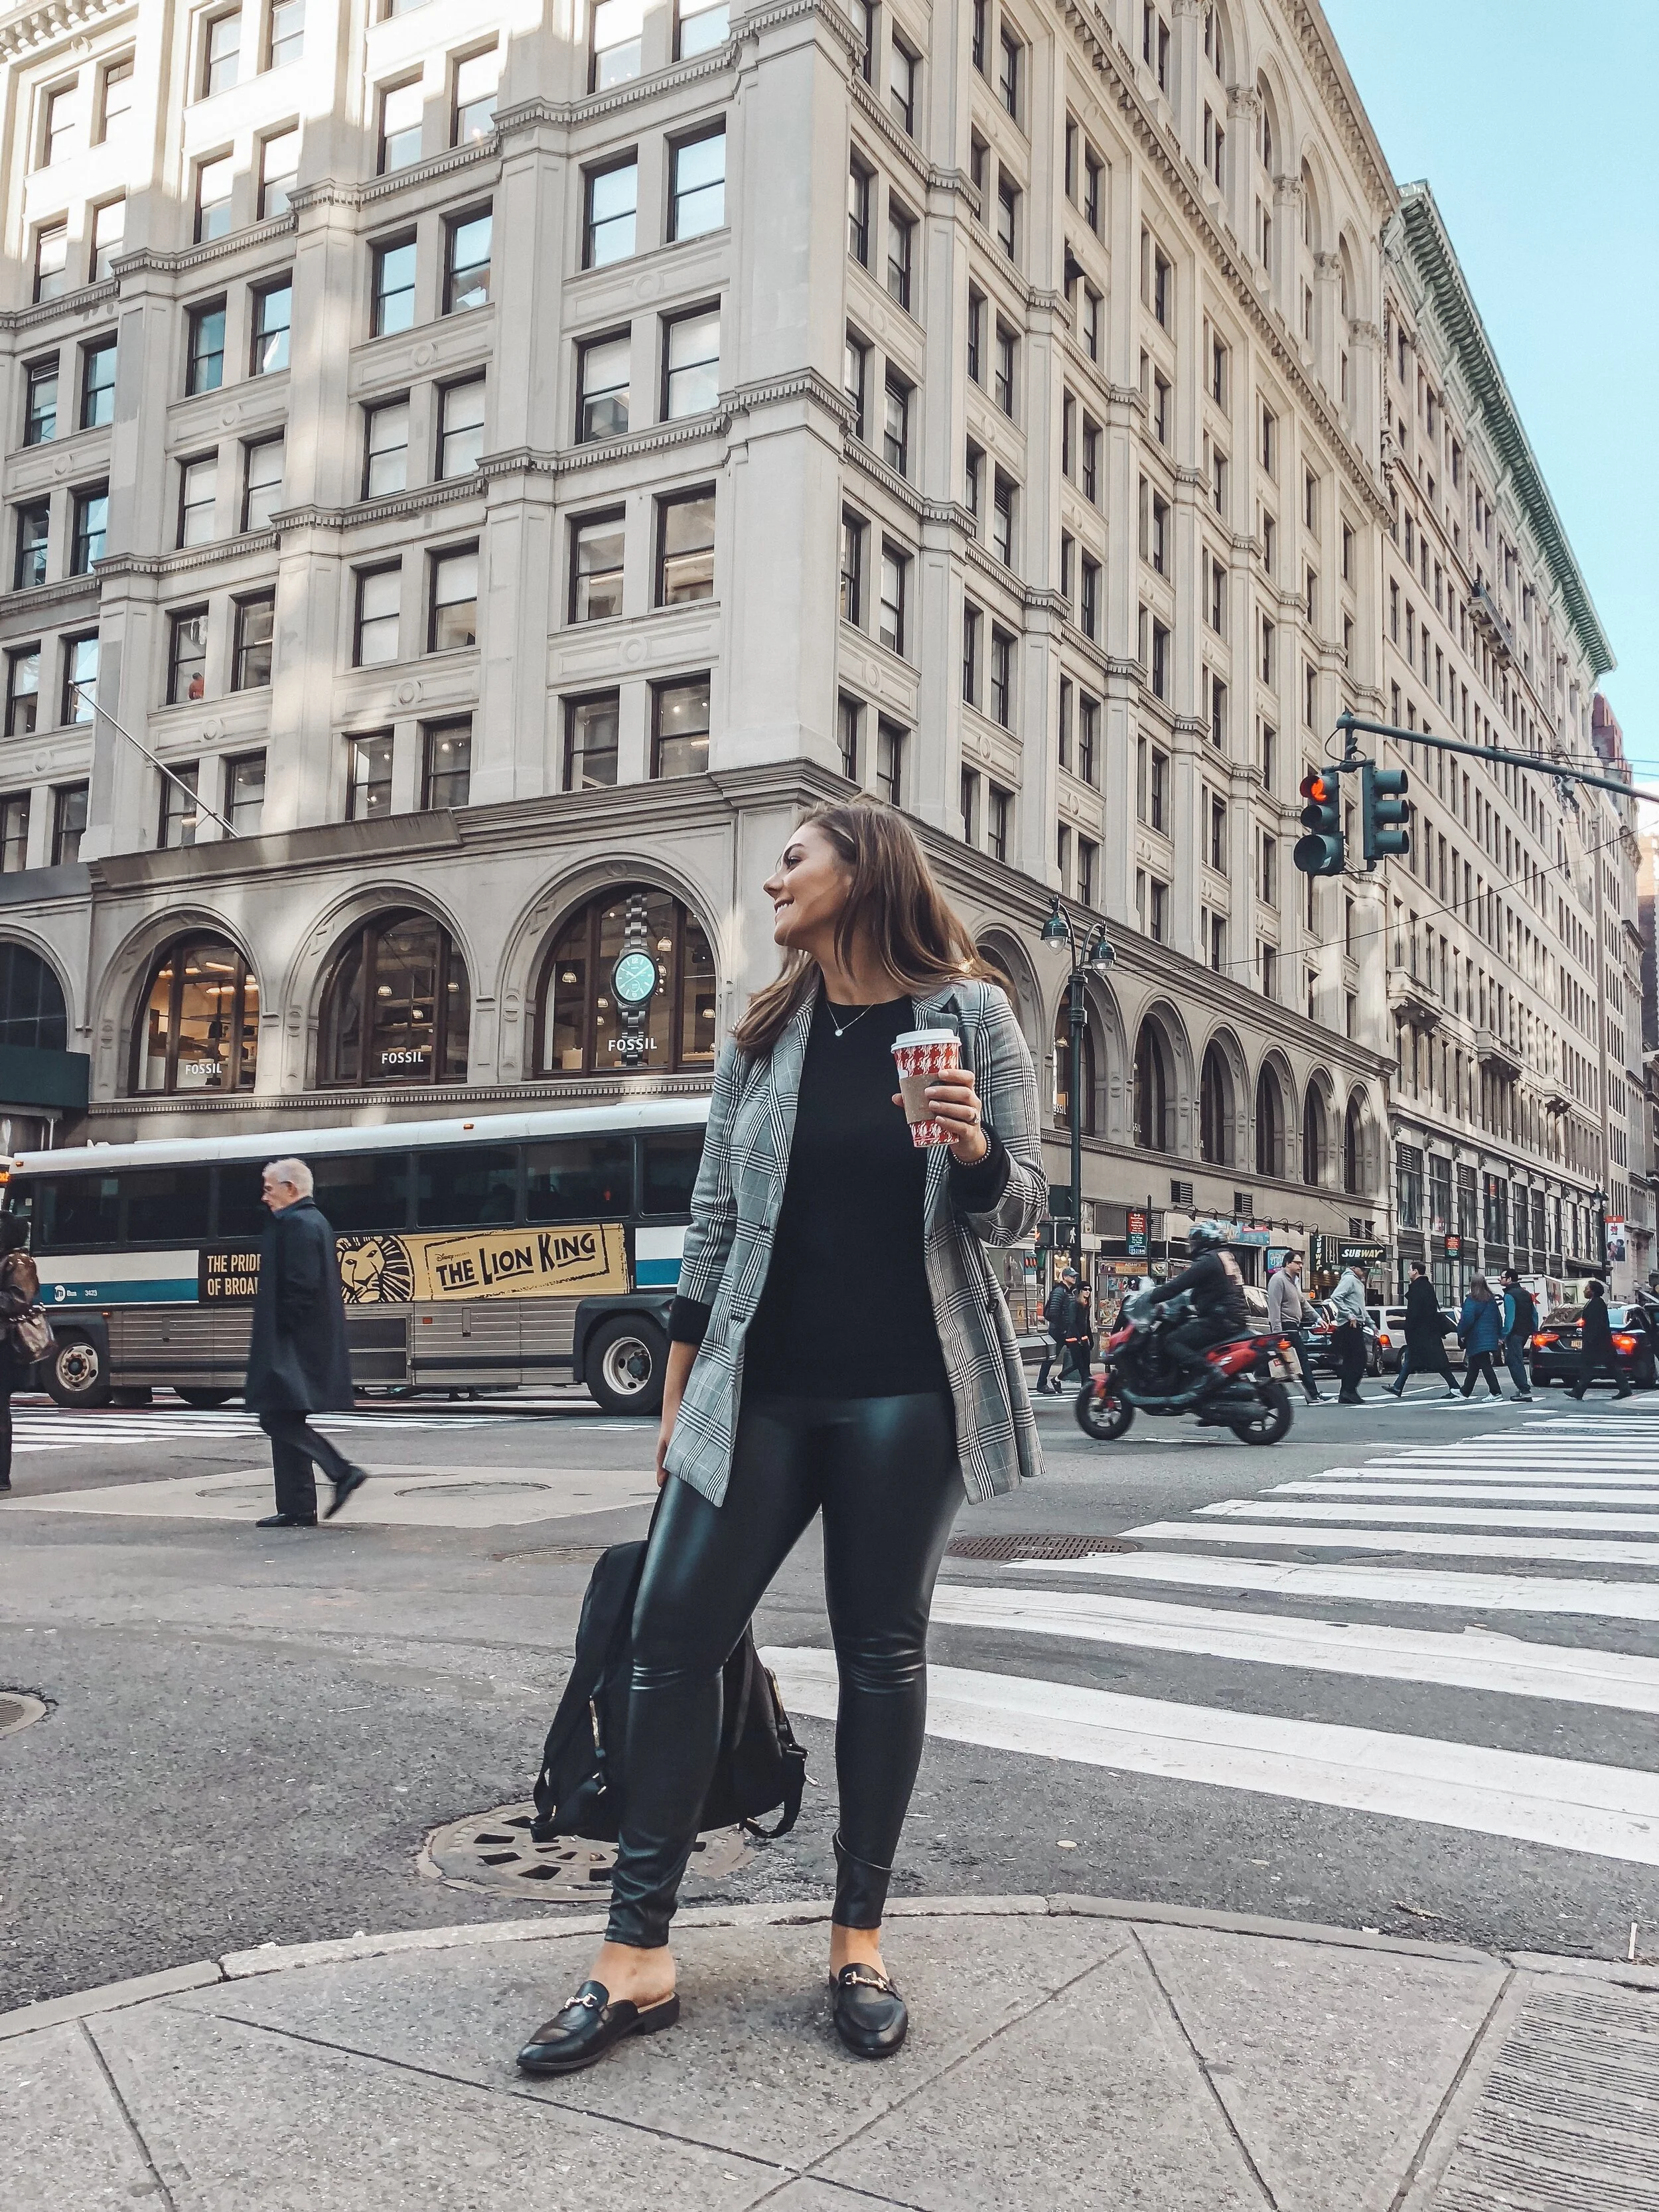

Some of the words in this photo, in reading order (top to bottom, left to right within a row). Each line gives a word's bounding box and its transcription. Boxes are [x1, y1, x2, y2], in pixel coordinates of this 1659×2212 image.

[609, 1038, 657, 1051] FOSSIL
[382, 1051, 423, 1064] FOSSIL
[186, 1063, 222, 1074] FOSSIL
[1053, 1104, 1066, 1115] SSIL
[435, 1258, 475, 1286] THE
[478, 1246, 534, 1286] LION
[538, 1232, 596, 1273] KING
[1342, 1249, 1383, 1258] SUBWAY
[207, 1255, 228, 1273] THE
[207, 1278, 222, 1295] OF
[224, 1277, 259, 1295] BROA
